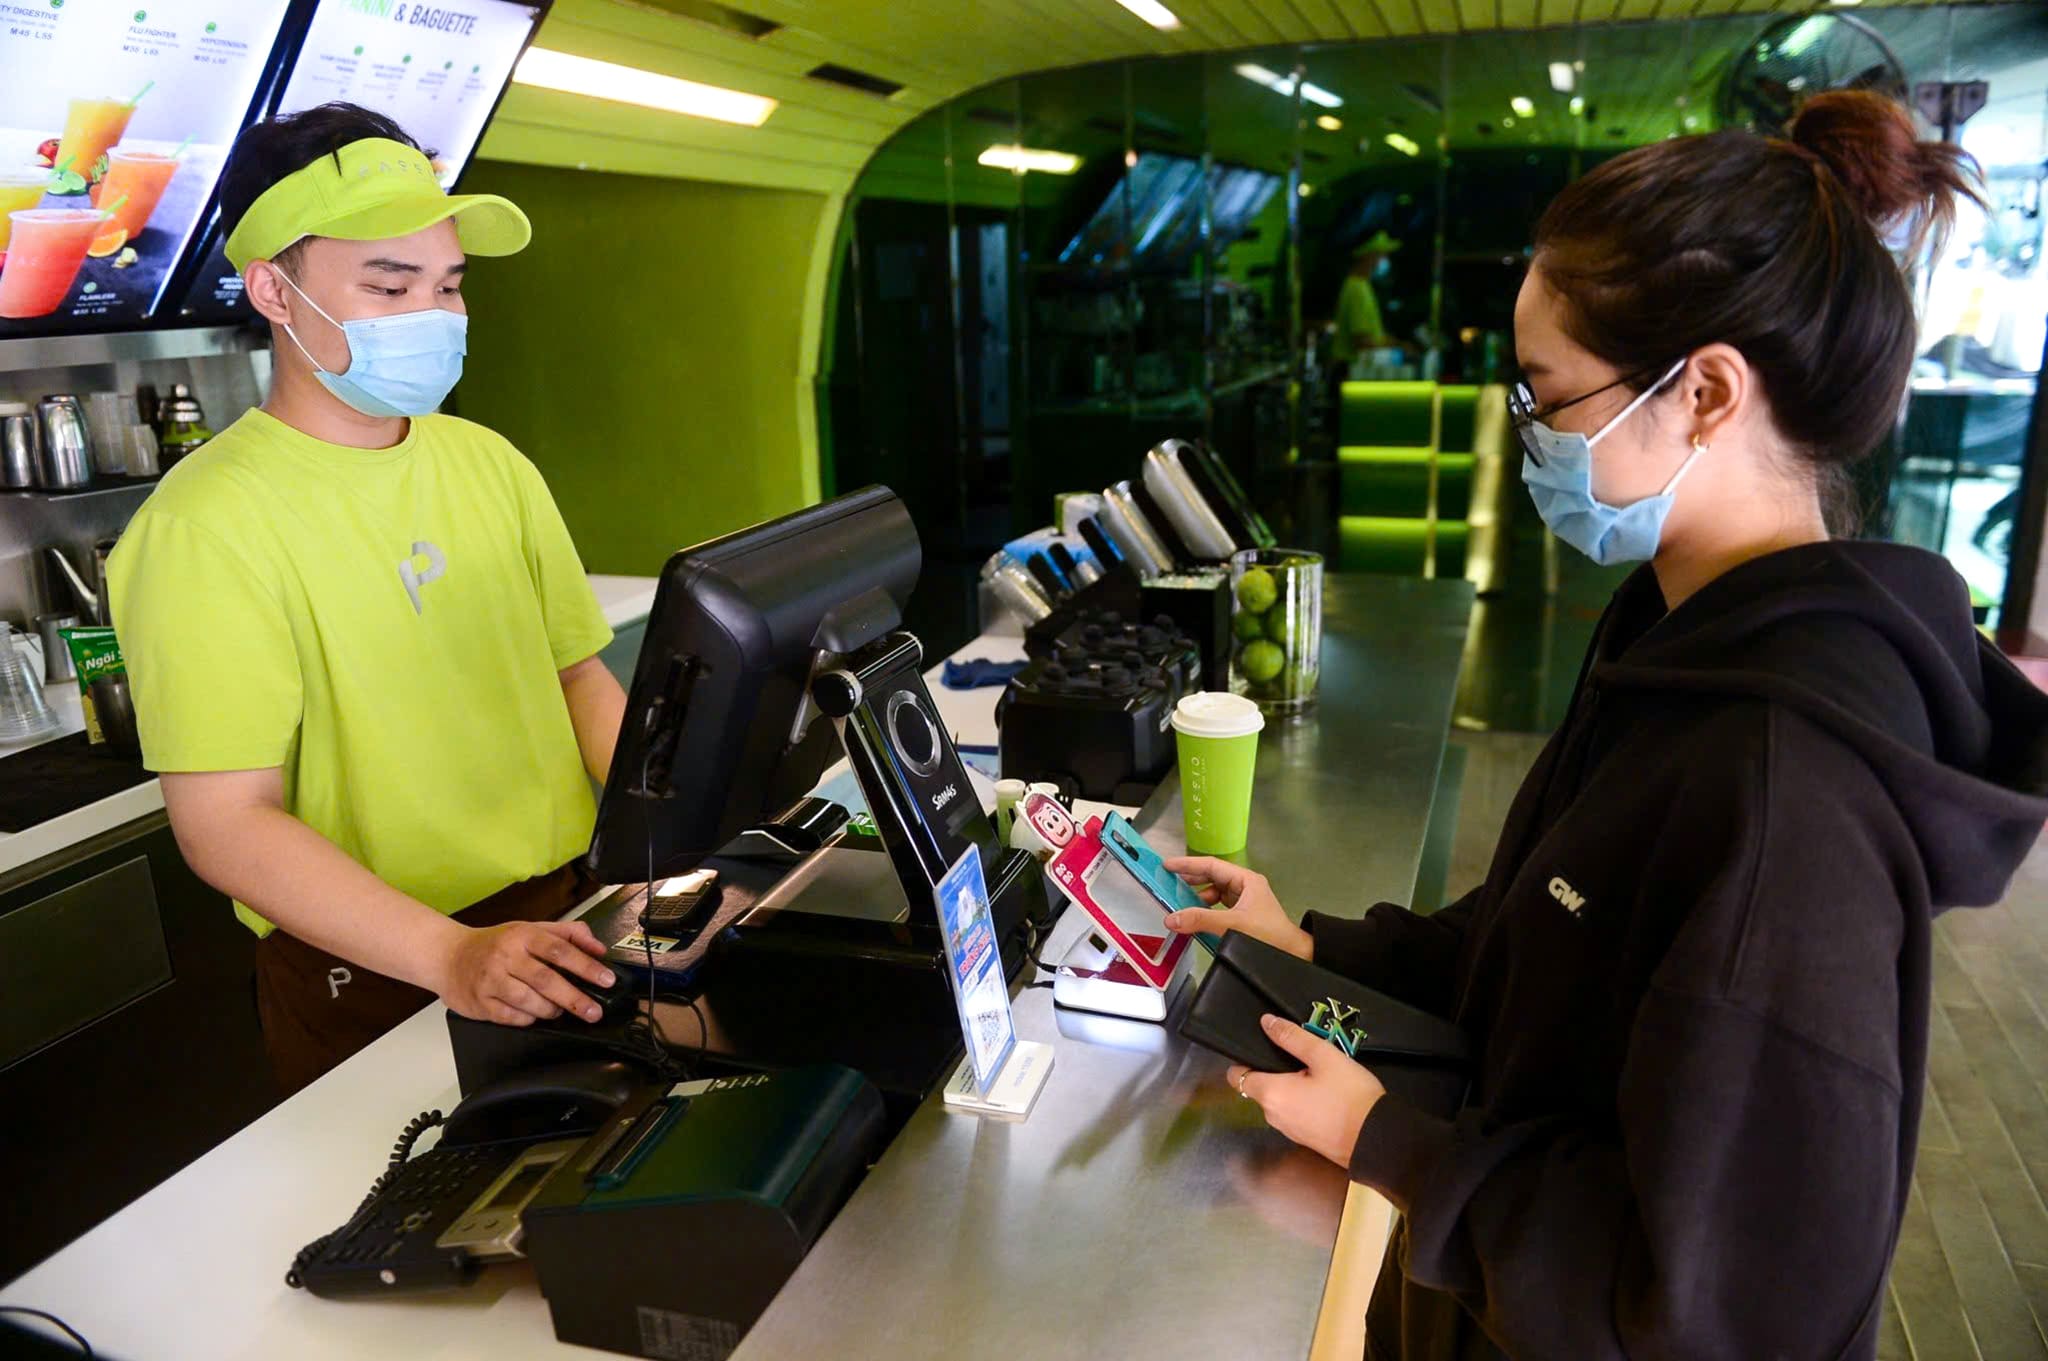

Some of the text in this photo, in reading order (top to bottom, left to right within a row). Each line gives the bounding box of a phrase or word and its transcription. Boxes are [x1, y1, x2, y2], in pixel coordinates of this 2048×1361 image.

[13, 7, 59, 21] DIGESTIVE
[394, 3, 407, 22] &
[409, 5, 478, 36] BAGUETTE
